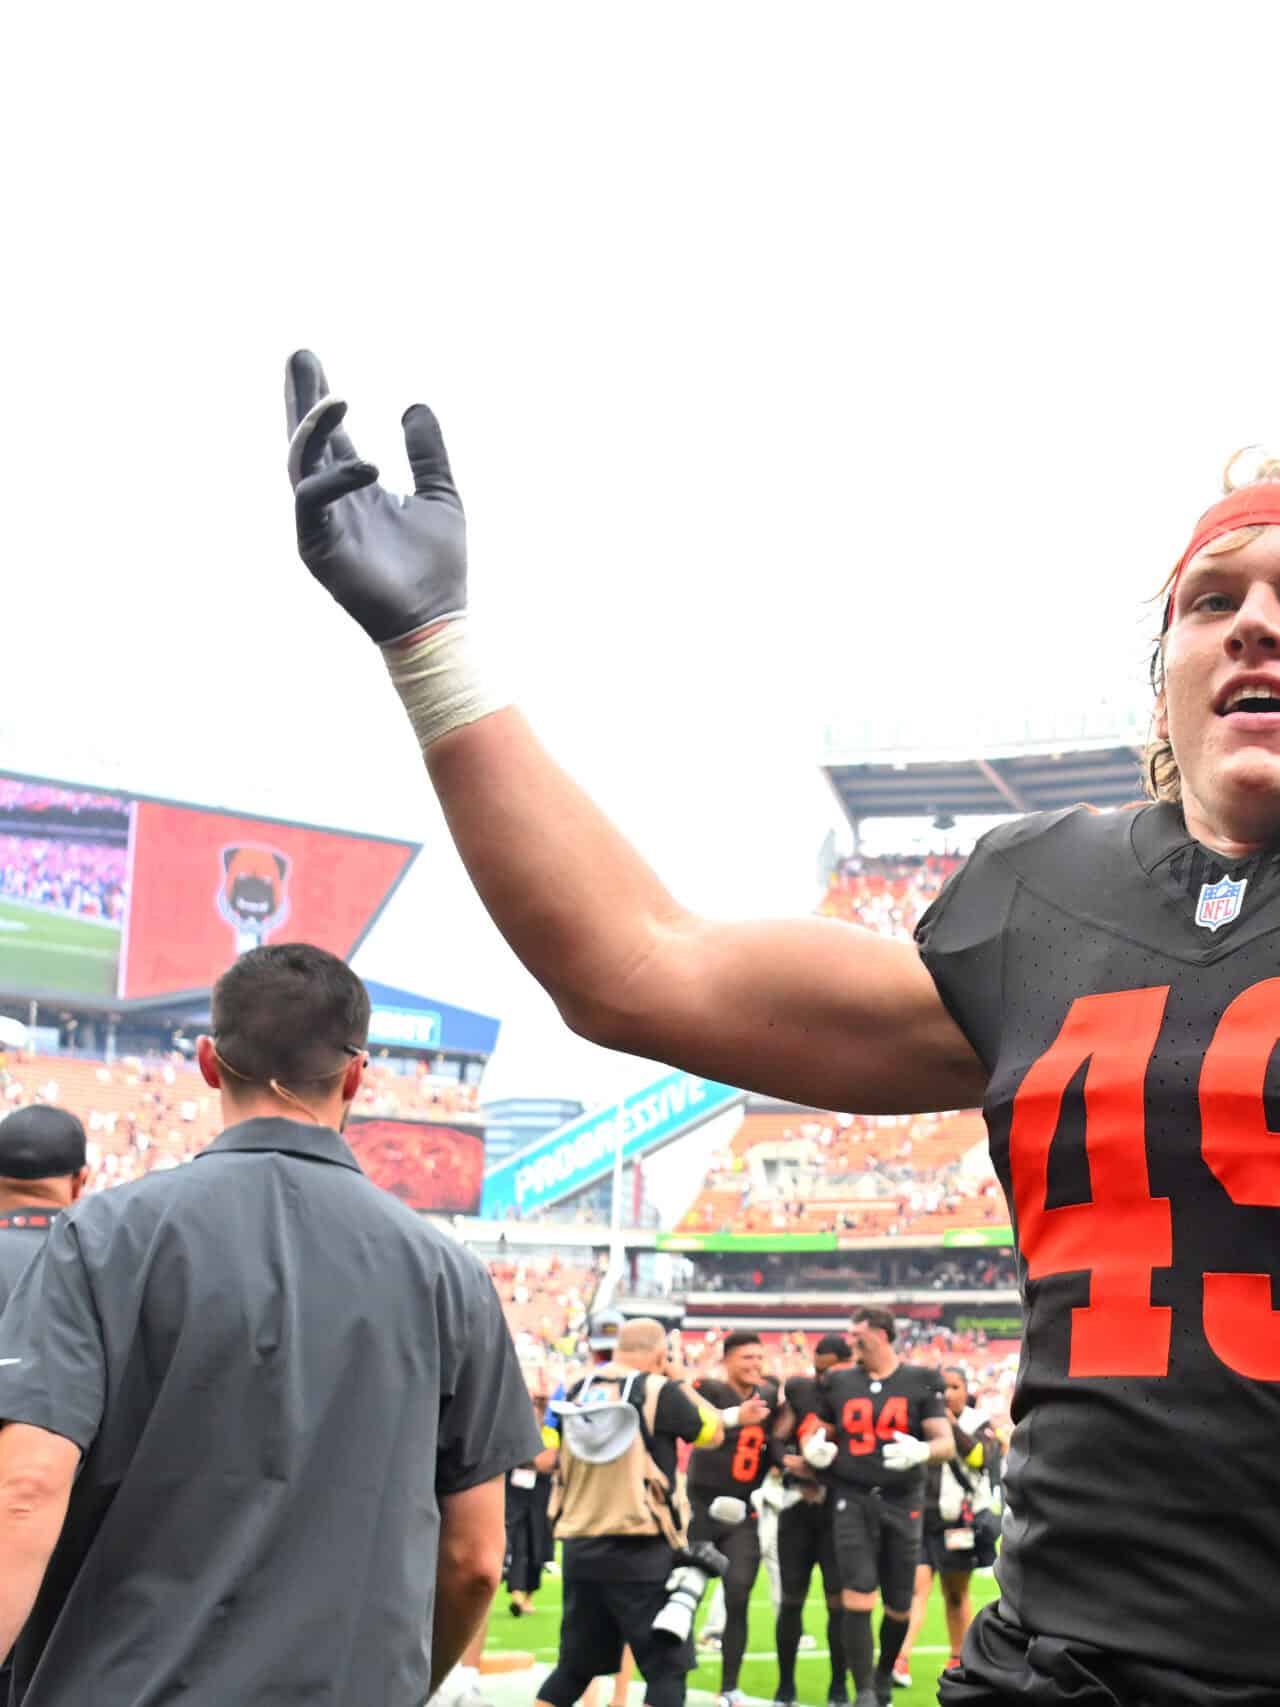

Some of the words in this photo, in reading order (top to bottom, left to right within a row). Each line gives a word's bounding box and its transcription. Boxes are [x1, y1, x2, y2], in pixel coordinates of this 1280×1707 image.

[1202, 899, 1232, 920] NFL
[732, 1424, 766, 1482] 8
[842, 1396, 910, 1456] 94
